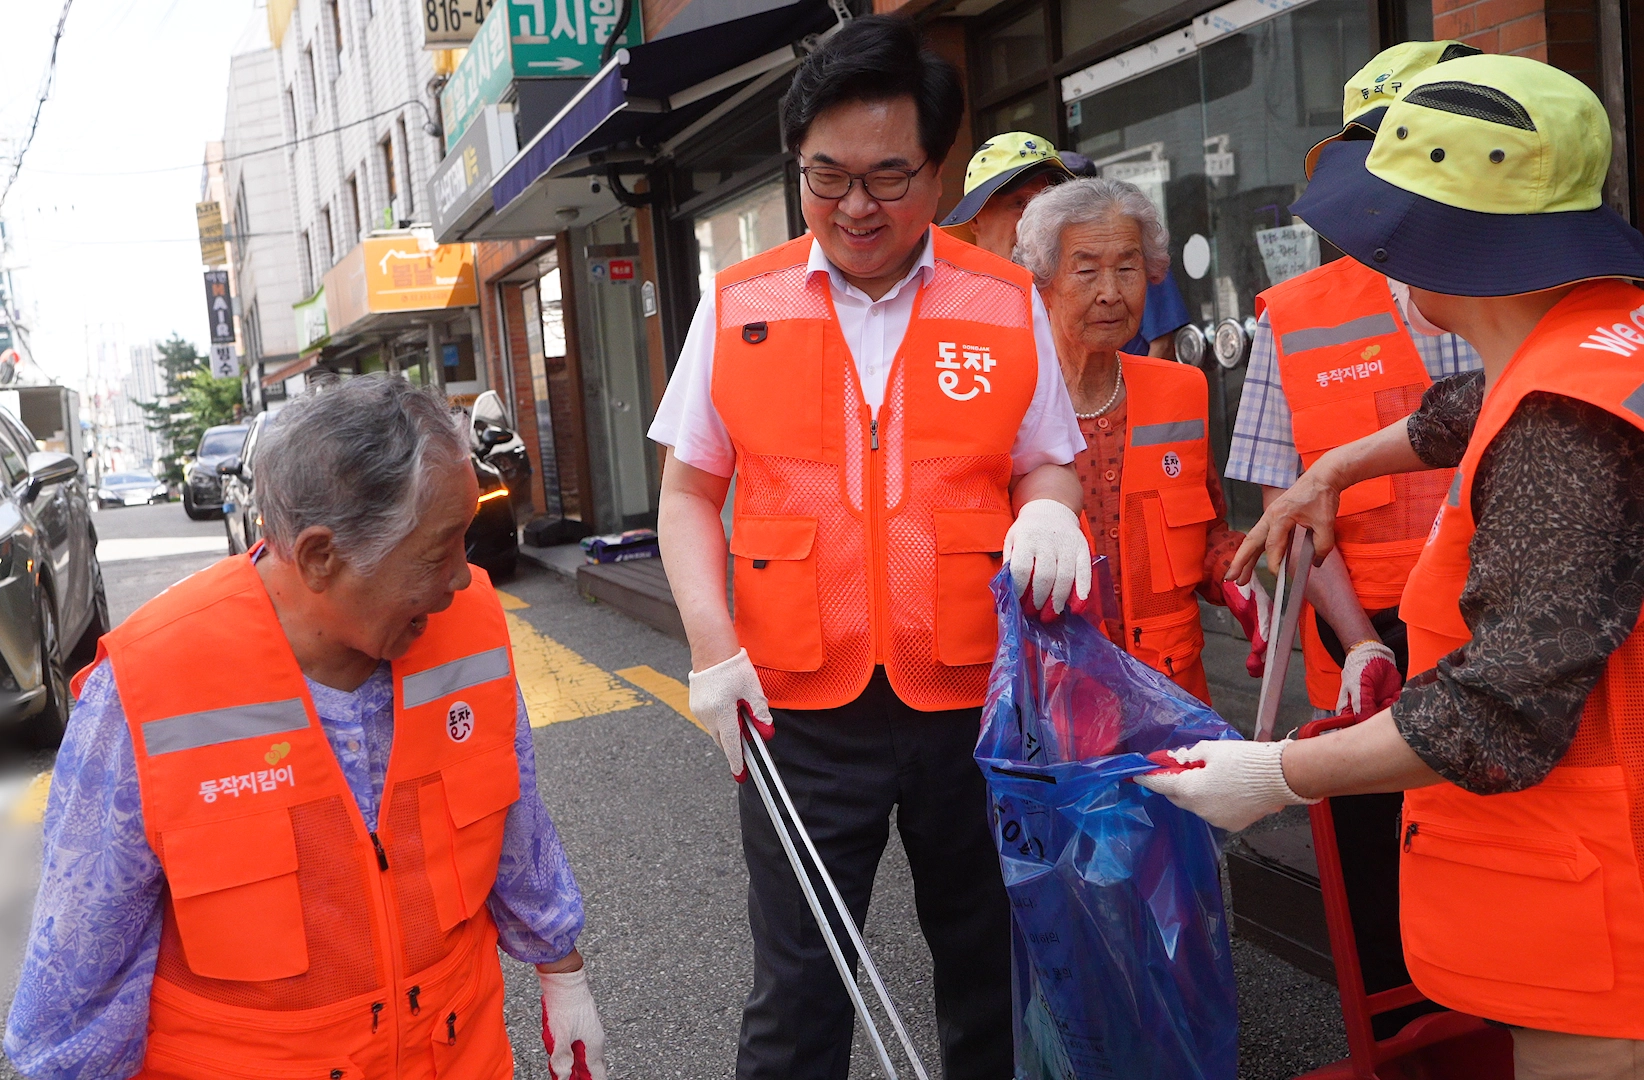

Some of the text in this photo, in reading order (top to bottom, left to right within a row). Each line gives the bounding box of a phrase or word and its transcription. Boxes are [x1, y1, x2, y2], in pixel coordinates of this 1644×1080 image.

[511, 0, 628, 45] 고시원
[1361, 81, 1402, 100] 동작구
[211, 283, 229, 337] HAIR
[962, 344, 990, 352] DONGJAK
[935, 341, 997, 401] 동작
[1316, 359, 1384, 388] 동작지킴이
[449, 709, 471, 741] 동작
[198, 764, 295, 803] 동작지킴이
